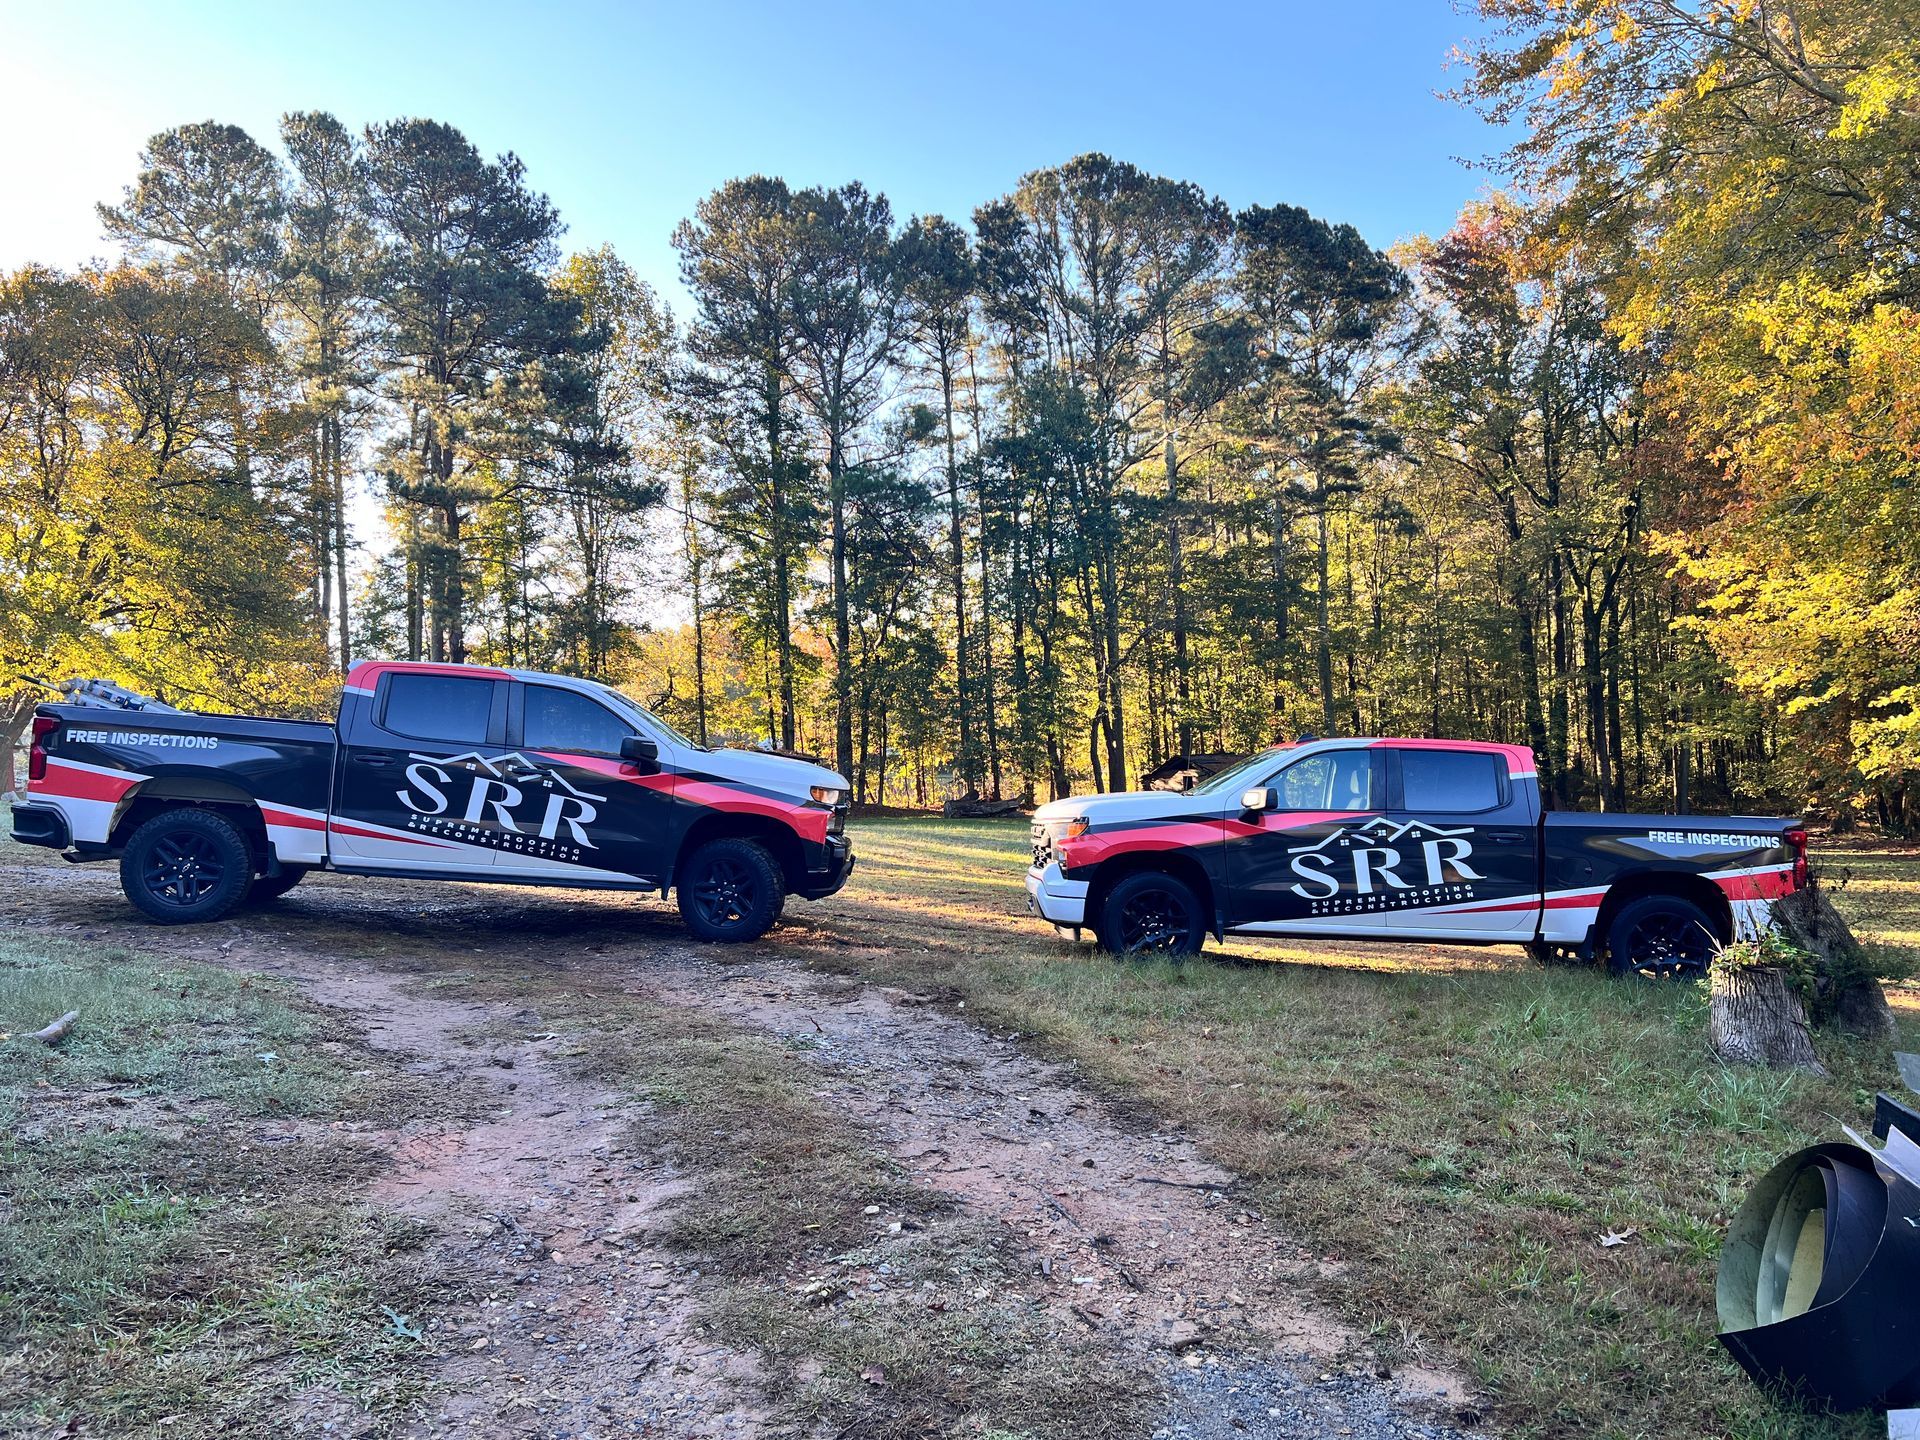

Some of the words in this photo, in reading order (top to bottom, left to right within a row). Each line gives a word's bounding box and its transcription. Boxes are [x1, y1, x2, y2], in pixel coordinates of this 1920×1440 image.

[66, 729, 107, 744] FREE
[111, 732, 218, 749] INSPECTIONS
[396, 763, 599, 850] SRR
[410, 813, 491, 836] SUPREME
[504, 834, 580, 855] ROOFING
[1648, 830, 1684, 844] FREE
[1687, 832, 1780, 849] INSPECTIONS
[1290, 838, 1487, 899] SRR
[1311, 895, 1386, 908] SUPREME
[1399, 884, 1472, 899] ROOFING
